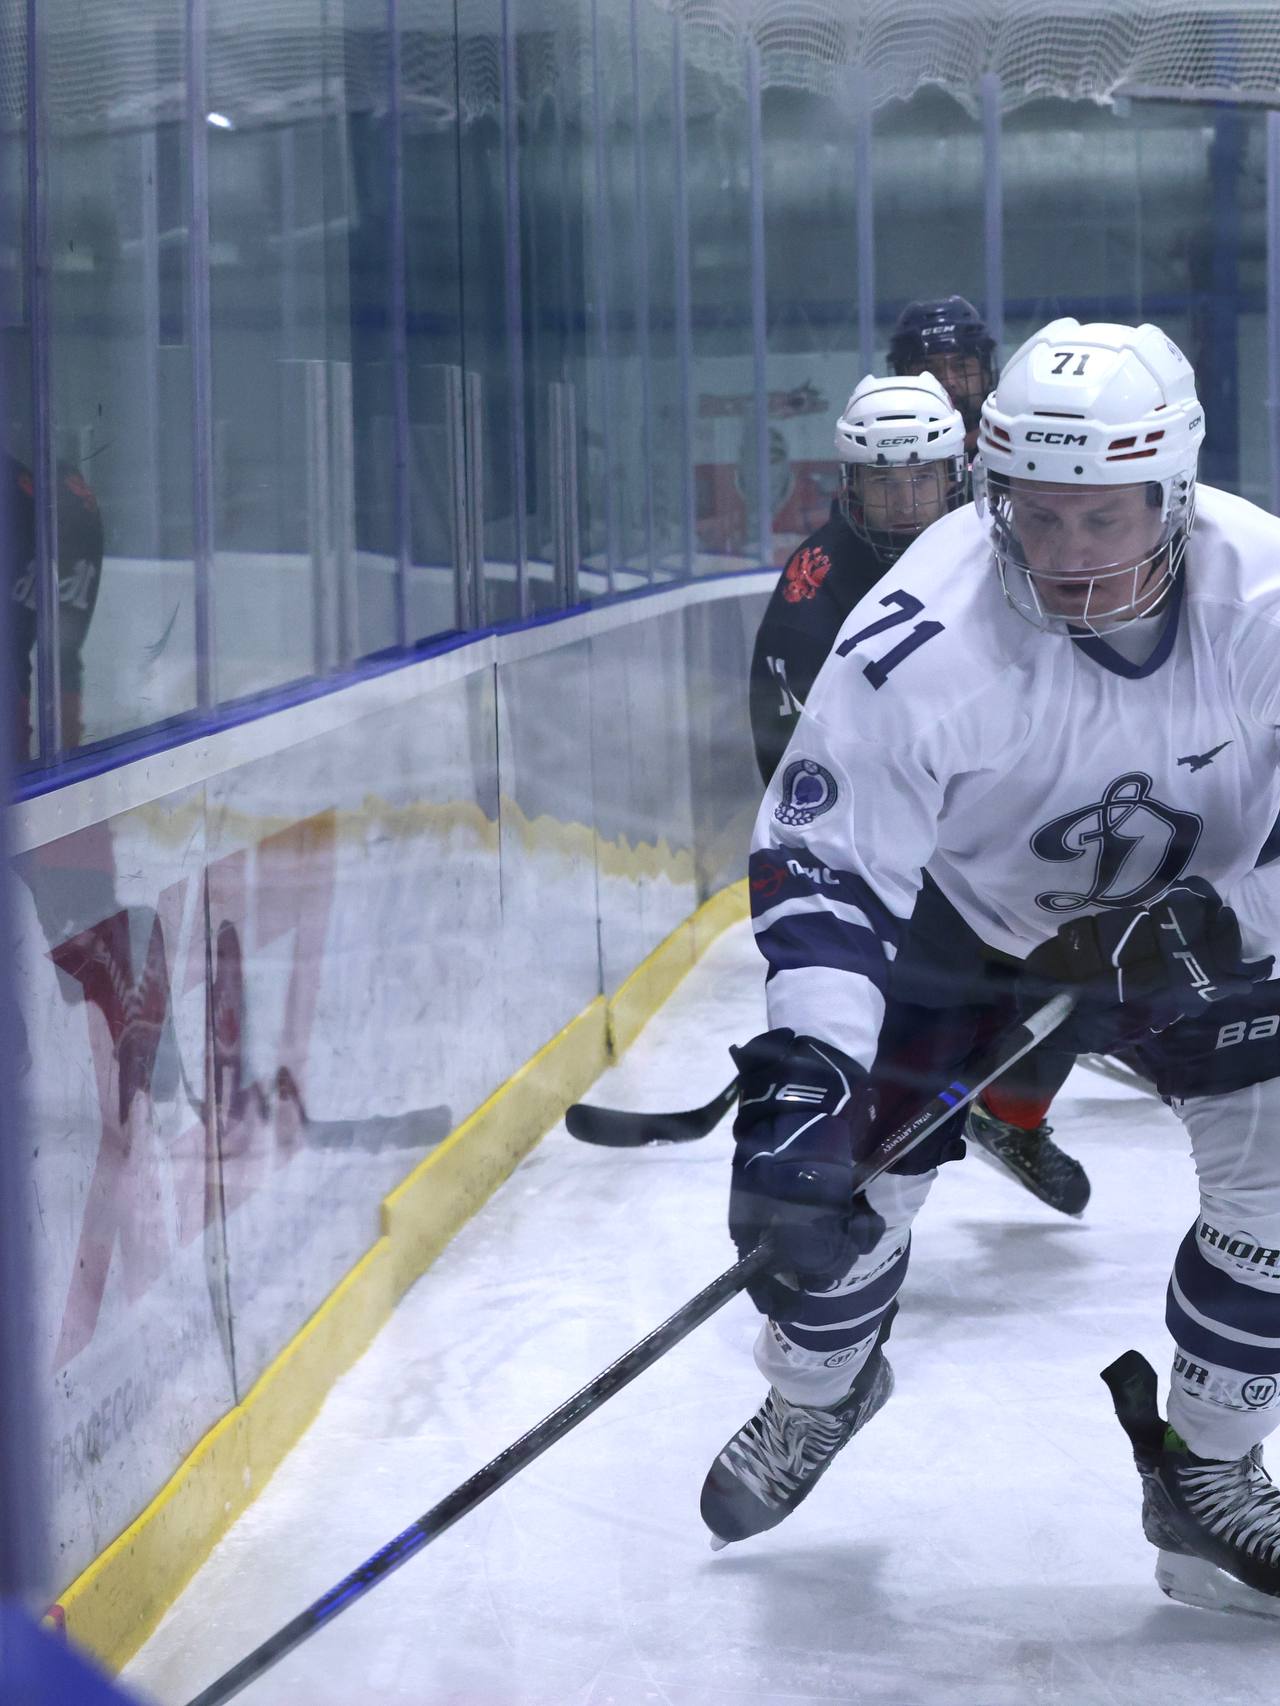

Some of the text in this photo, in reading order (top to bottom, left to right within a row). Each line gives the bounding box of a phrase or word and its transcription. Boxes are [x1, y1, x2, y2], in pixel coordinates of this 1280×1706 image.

[921, 325, 956, 336] CCM
[1051, 352, 1090, 375] 71
[881, 438, 915, 447] CCM
[1025, 431, 1088, 446] CCM
[835, 589, 946, 692] 71
